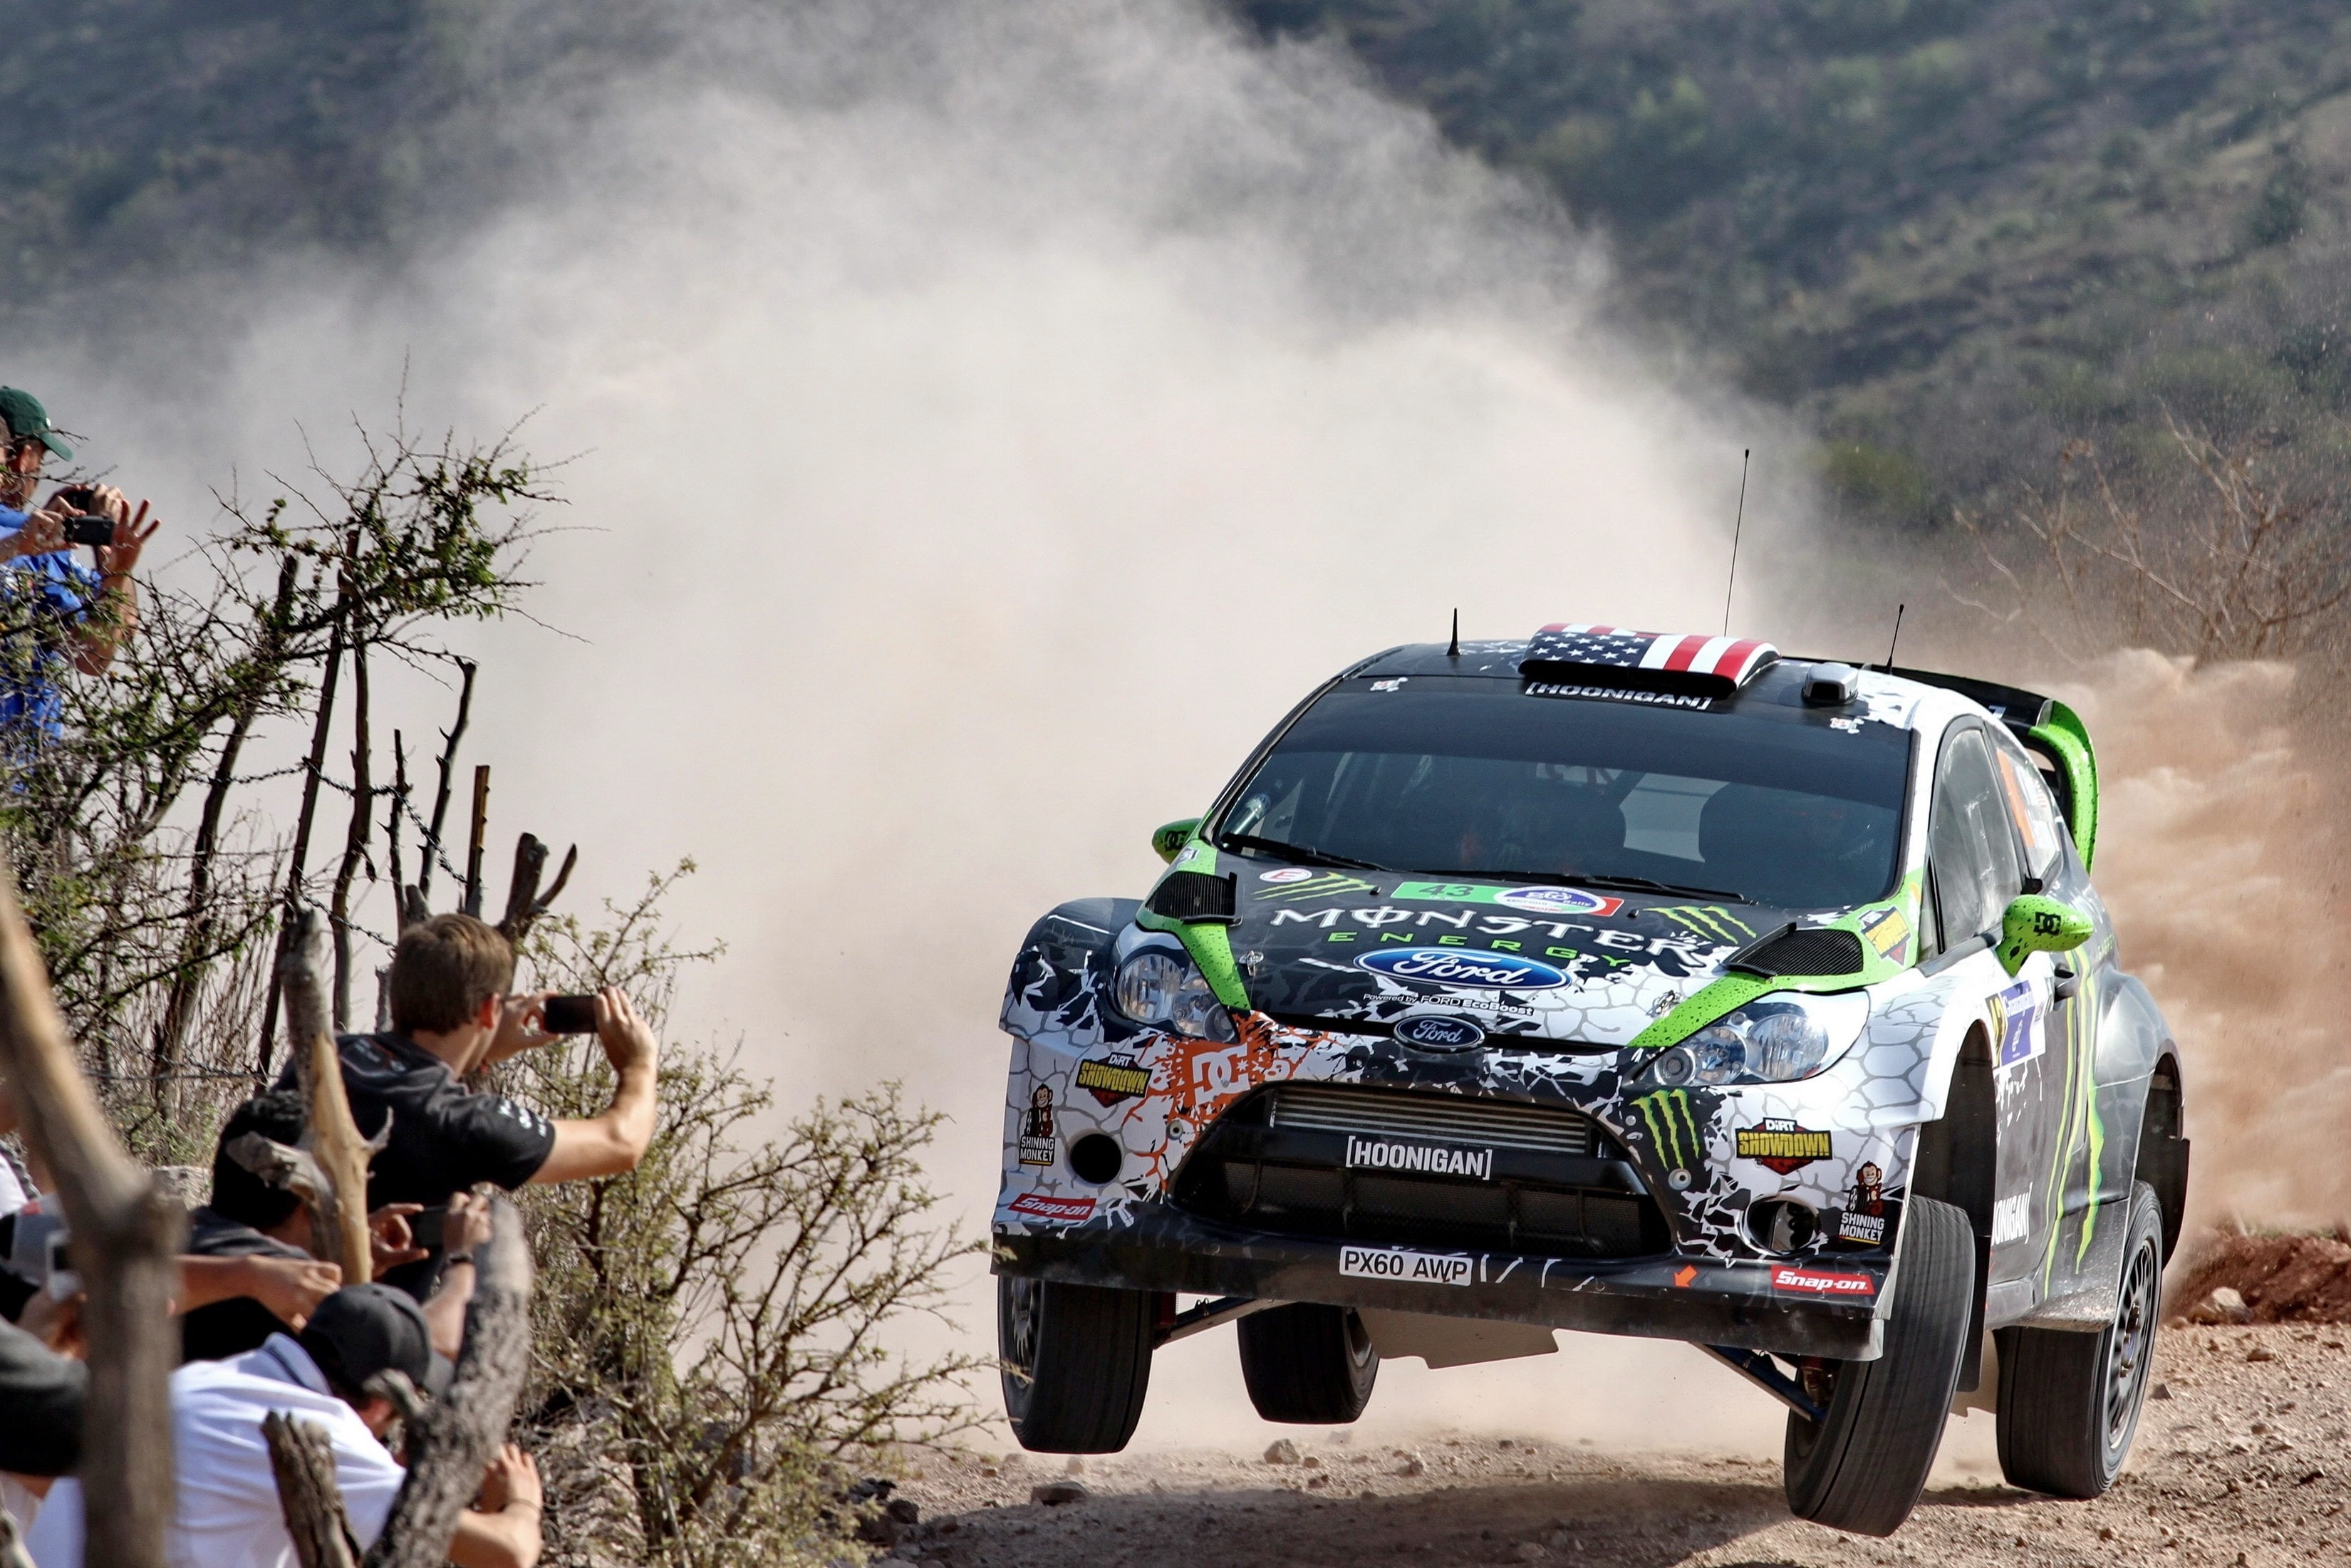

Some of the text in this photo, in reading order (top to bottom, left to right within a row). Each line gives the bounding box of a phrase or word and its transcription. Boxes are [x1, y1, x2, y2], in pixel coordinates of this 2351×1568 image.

[1525, 681, 1713, 711] [HOONIGAN]
[1418, 884, 1475, 897] 43
[2033, 912, 2062, 935] DC
[1327, 931, 1631, 967] ENERGY
[1392, 950, 1532, 985] Ford
[1363, 993, 1535, 1017] Powered by FORD EcoBoost
[1413, 1019, 1463, 1043] Ford
[1078, 1063, 1151, 1094] SHOWDOWN
[1192, 1042, 1251, 1106] DC
[1019, 1148, 1054, 1162] MONKEY
[1021, 1136, 1054, 1151] SHINING
[1738, 1131, 1830, 1158] SHOWDOWN
[1345, 1136, 1493, 1180] [HOONIGAN]
[1016, 1198, 1091, 1215] Snap-on
[1839, 1223, 1883, 1242] MONKEY
[1841, 1212, 1885, 1230] SHINING
[1344, 1250, 1468, 1282] PX60 AWP
[1775, 1270, 1867, 1291] Snap-on
